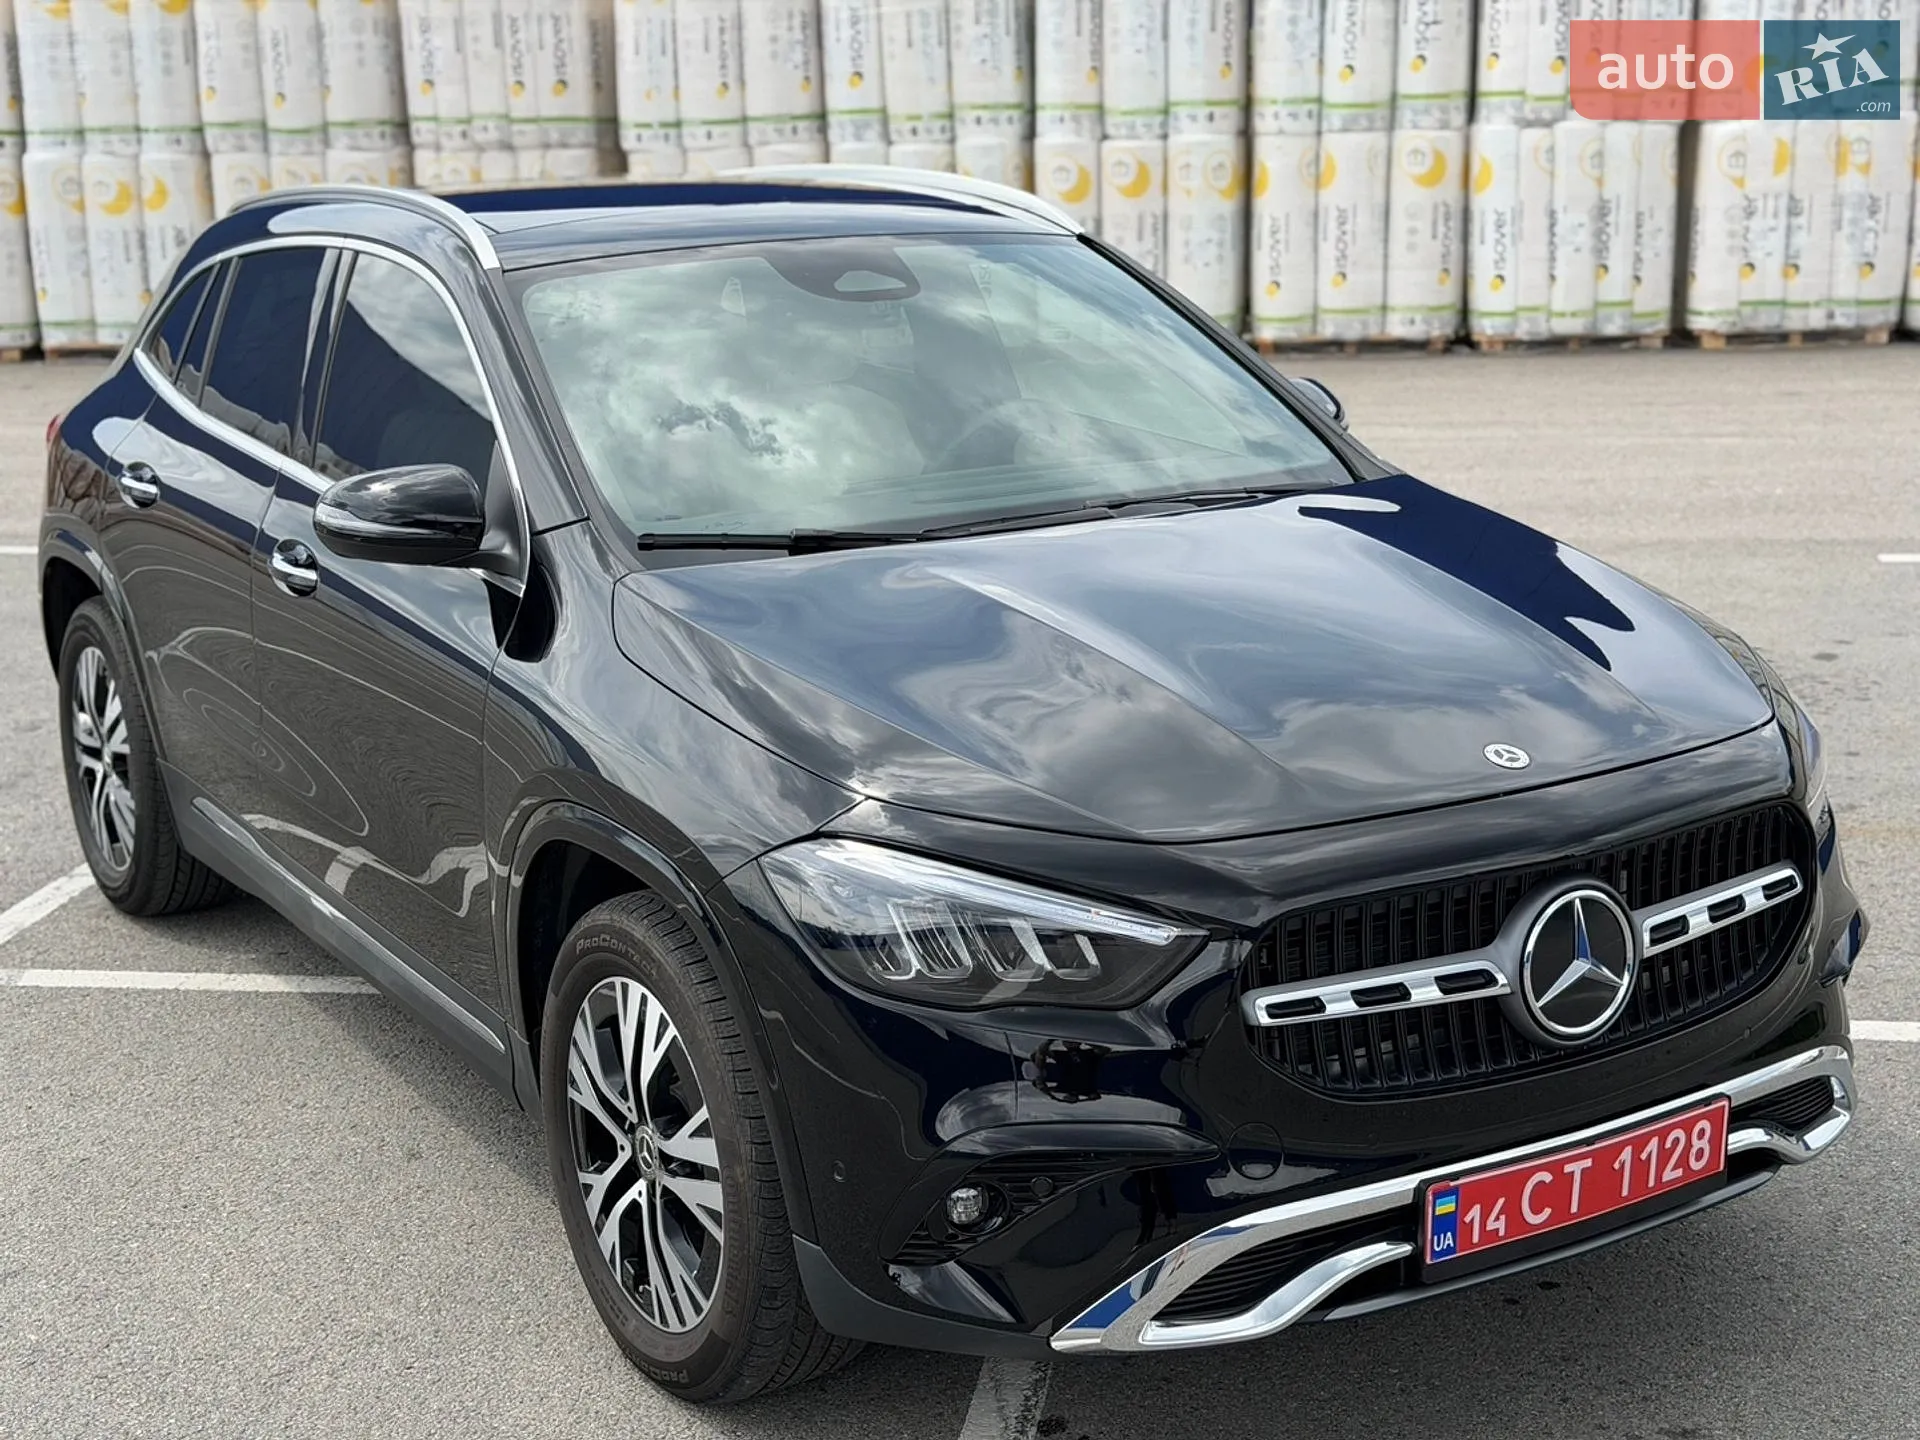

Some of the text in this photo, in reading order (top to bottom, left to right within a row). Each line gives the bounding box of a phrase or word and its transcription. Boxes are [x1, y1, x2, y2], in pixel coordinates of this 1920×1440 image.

[1463, 1118, 1712, 1244] 14 CT 1128
[1433, 1231, 1454, 1252] UA
